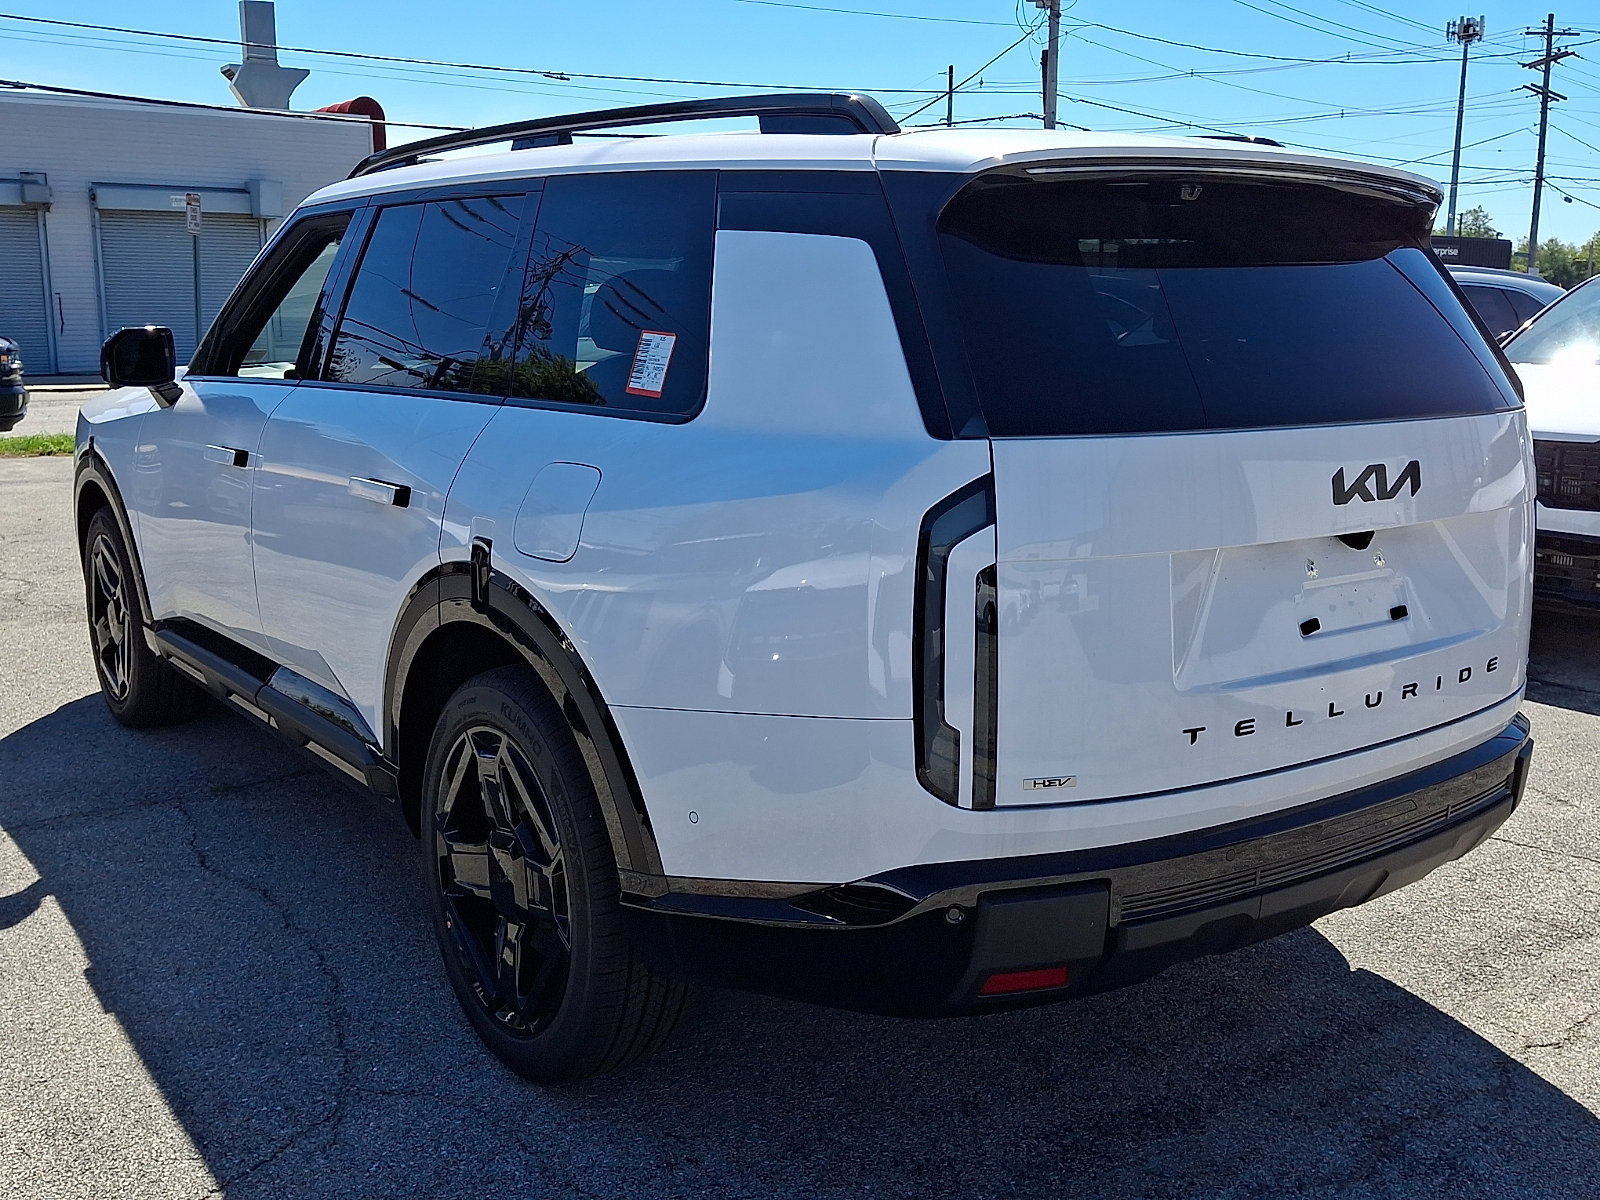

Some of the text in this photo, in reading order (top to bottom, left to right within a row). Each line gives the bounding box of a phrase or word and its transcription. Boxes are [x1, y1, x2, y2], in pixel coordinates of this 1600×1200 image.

[1433, 247, 1459, 257] erprise
[1331, 460, 1421, 505] KIA
[1182, 656, 1499, 745] TELLURIDE
[500, 702, 542, 757] KUMHO
[1033, 777, 1072, 788] HEV
